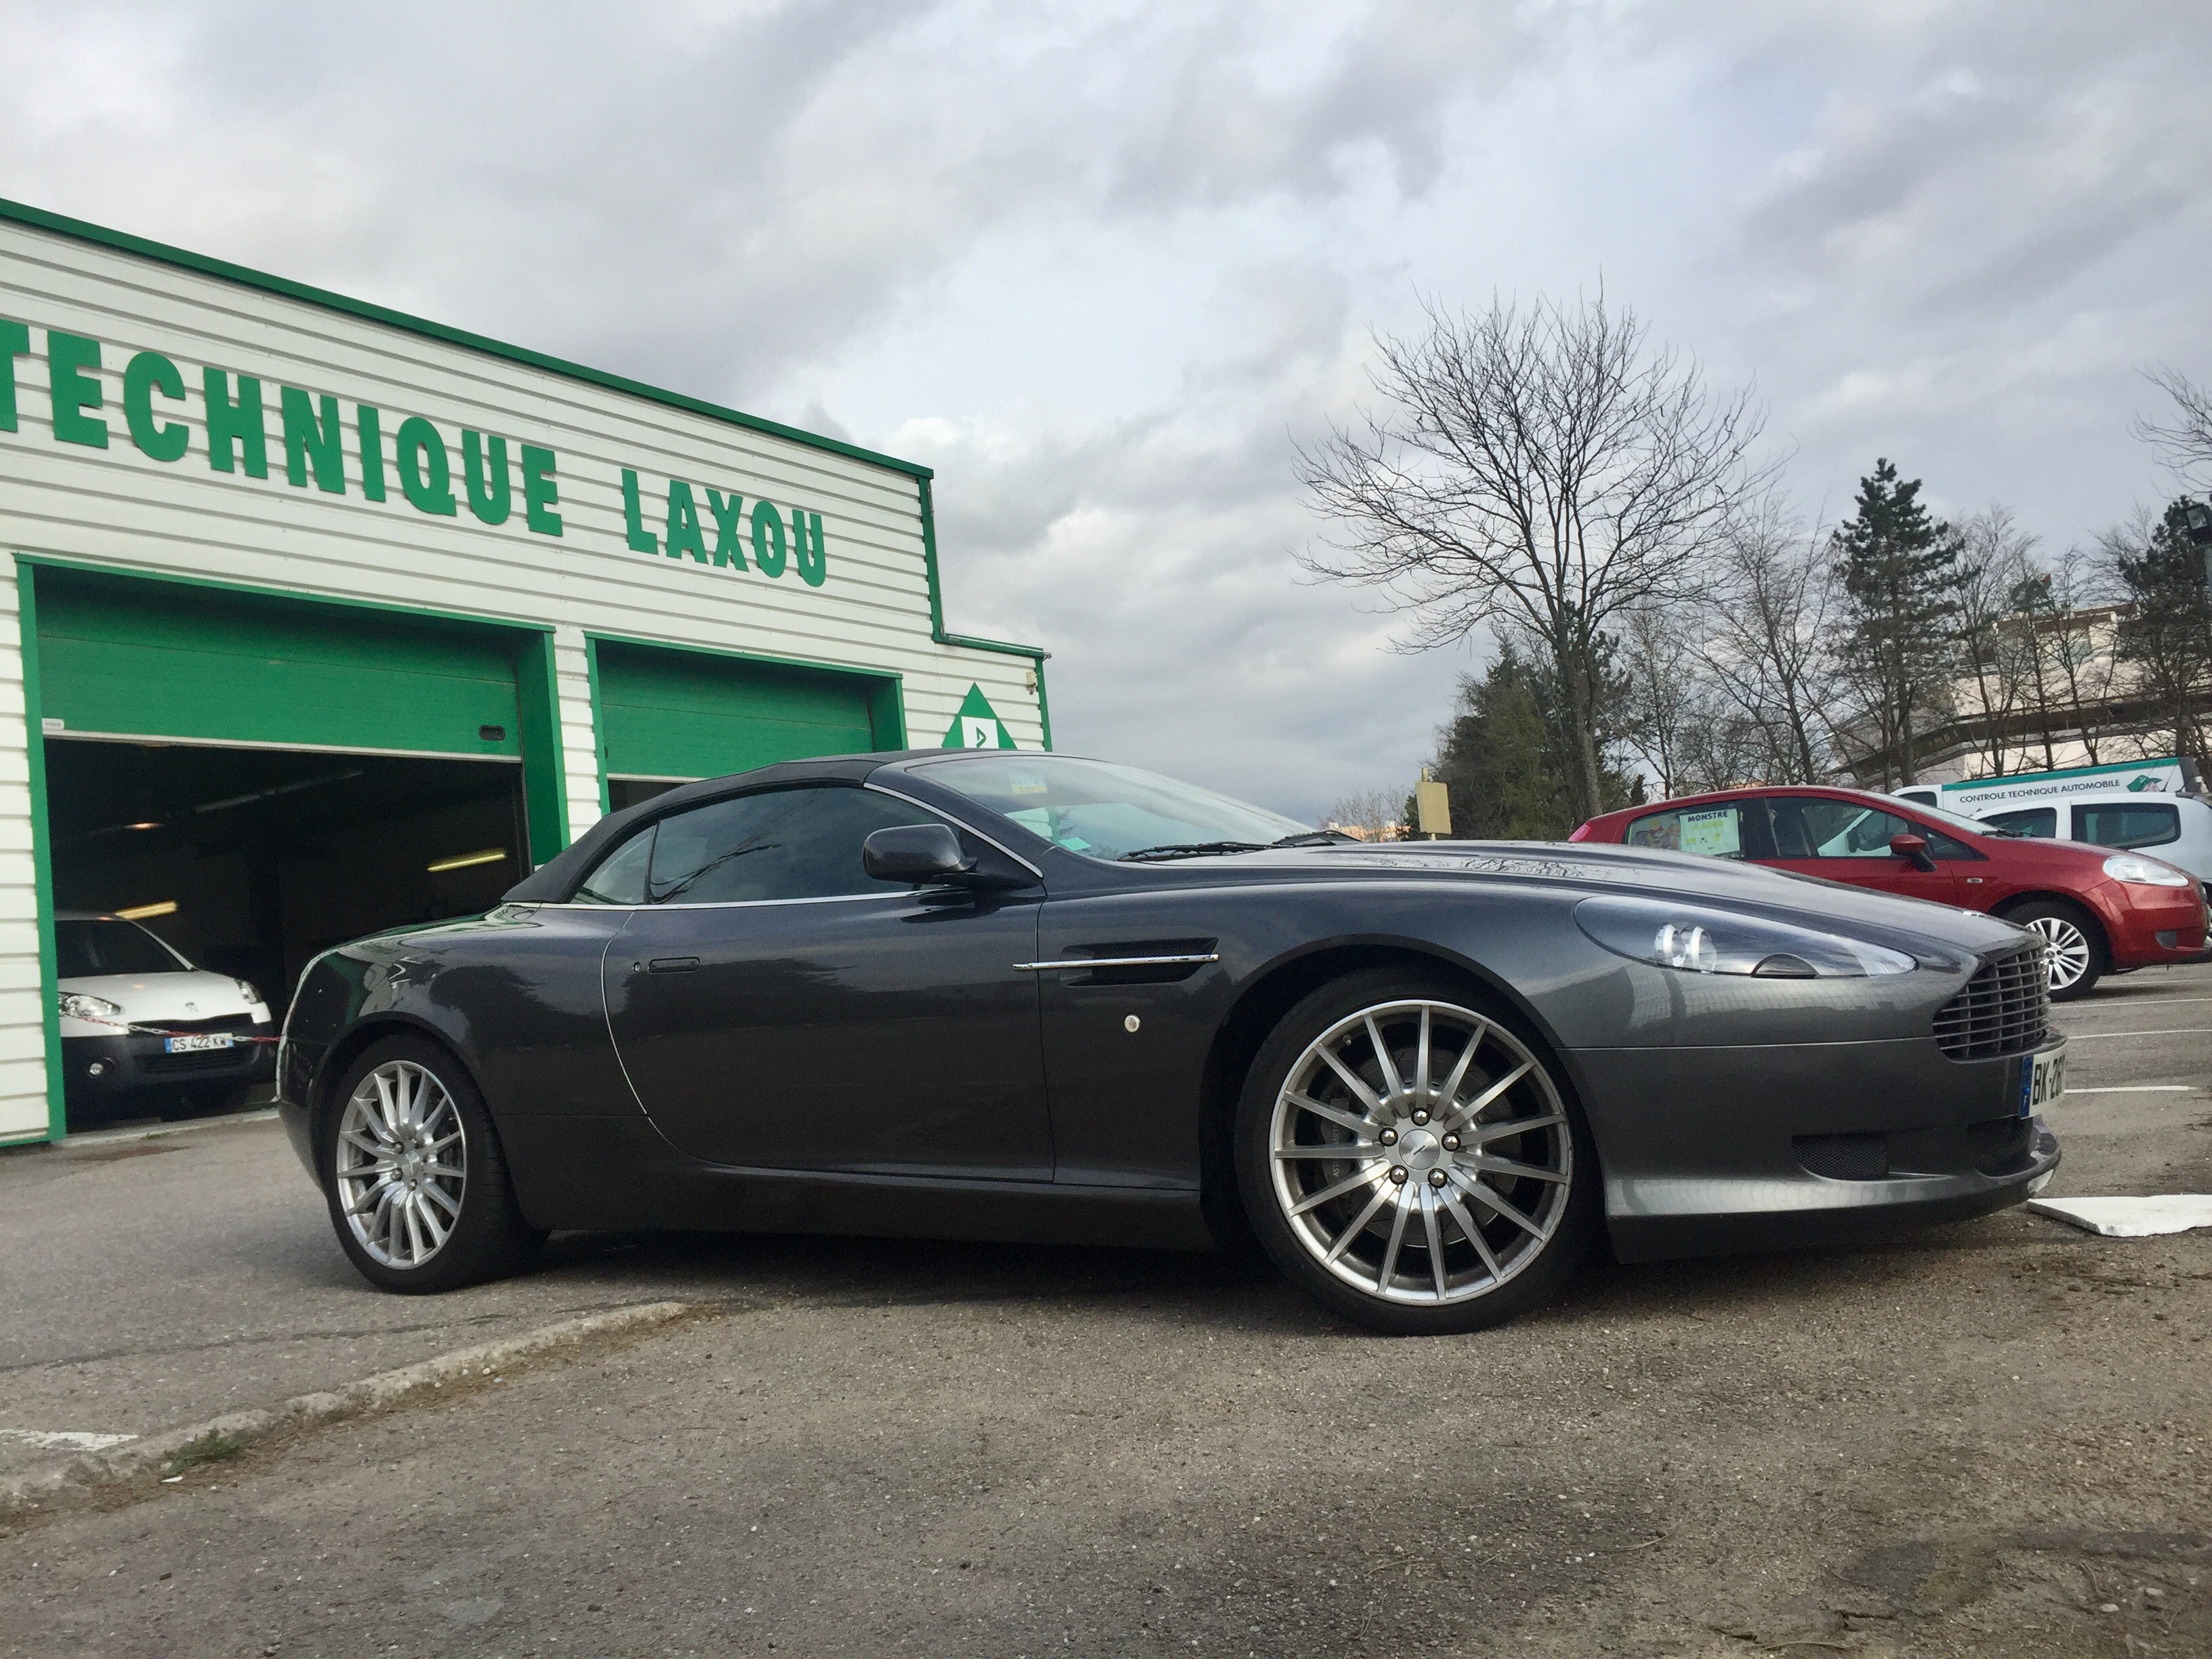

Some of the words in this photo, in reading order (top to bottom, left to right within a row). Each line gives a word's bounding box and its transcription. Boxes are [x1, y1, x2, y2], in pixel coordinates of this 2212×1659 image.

[0, 319, 563, 537] TECHNIQUE
[621, 468, 826, 588] LAXOU
[1960, 792, 2005, 803] CONTROLE
[2008, 786, 2058, 798] TECHNIQUE
[2061, 779, 2120, 792] AUTOMOBILE
[1687, 810, 1728, 823] MONSTRE
